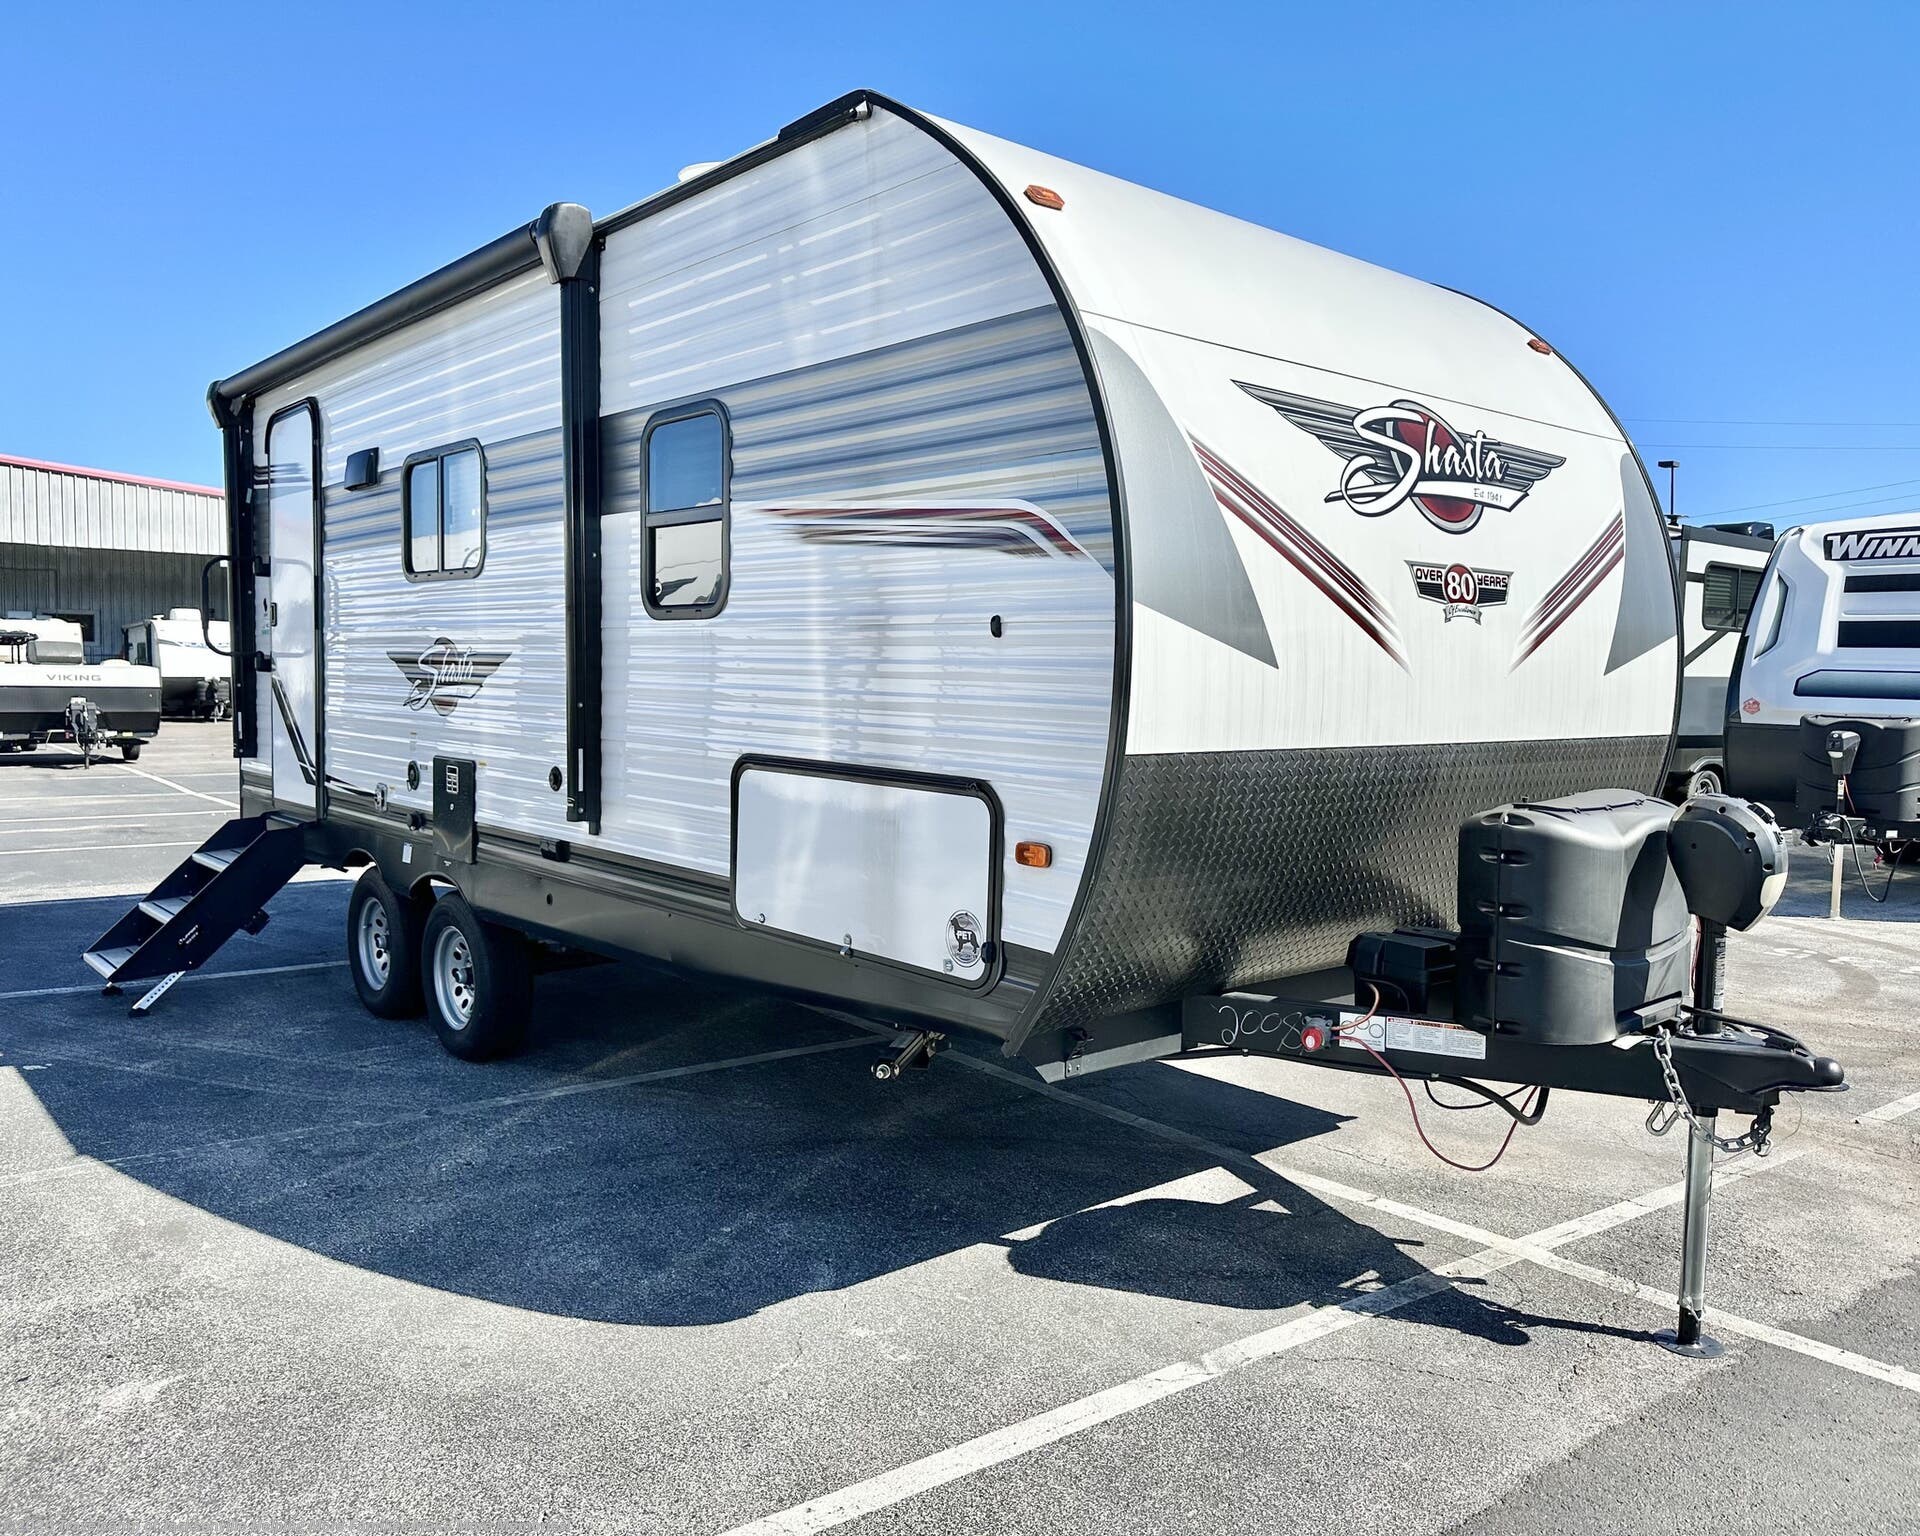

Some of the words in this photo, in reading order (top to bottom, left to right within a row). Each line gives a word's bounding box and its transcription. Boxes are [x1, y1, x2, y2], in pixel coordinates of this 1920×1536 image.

[1325, 406, 1506, 516] Shasta
[1415, 567, 1443, 582] OVER
[1447, 571, 1475, 601] 80
[1476, 573, 1508, 588] YEARS
[956, 930, 973, 941] PET
